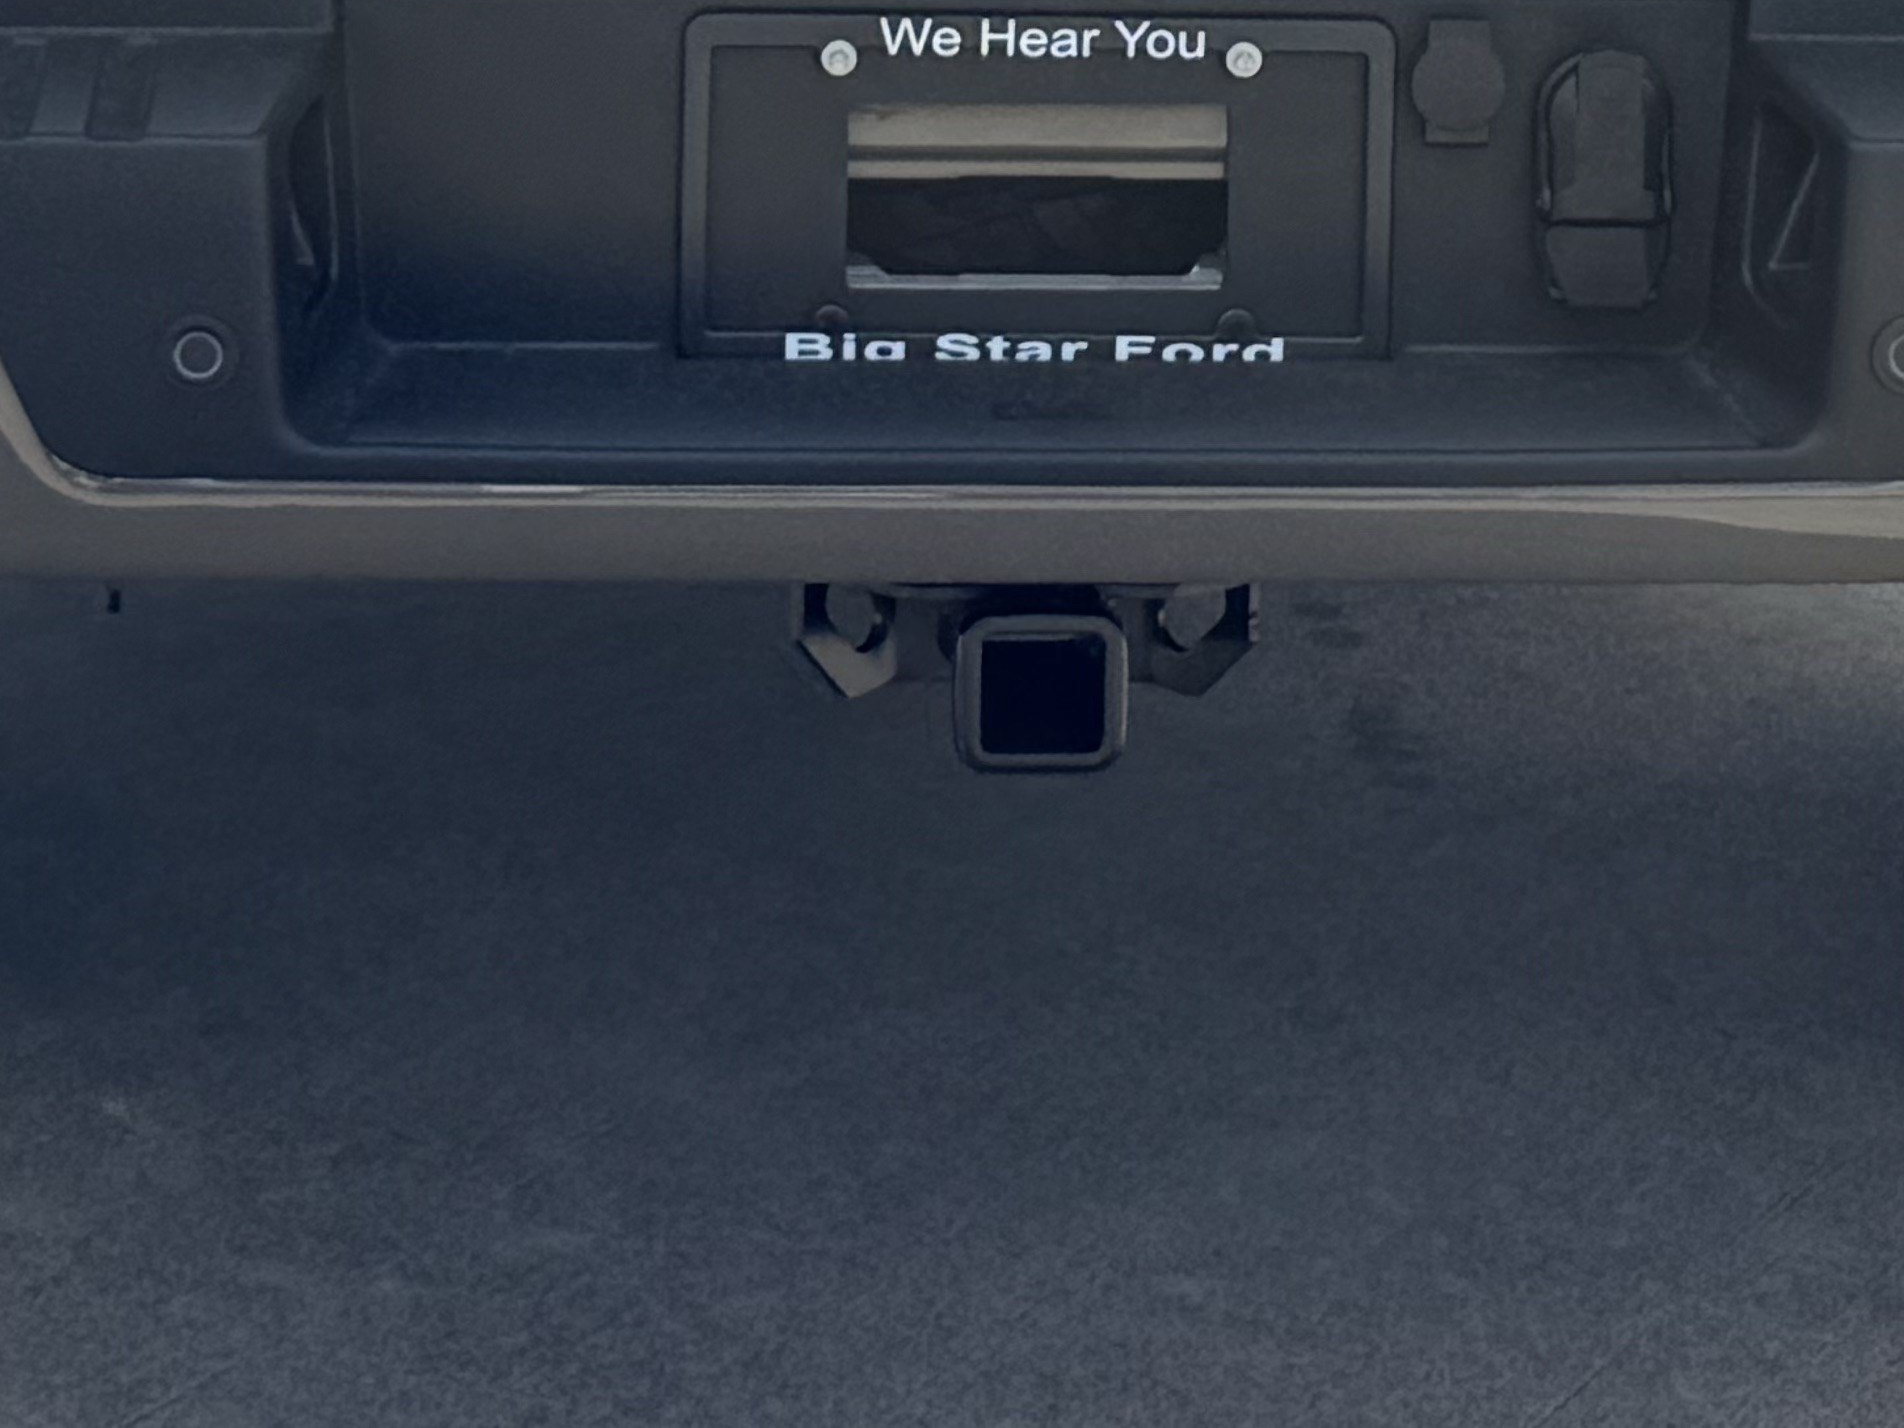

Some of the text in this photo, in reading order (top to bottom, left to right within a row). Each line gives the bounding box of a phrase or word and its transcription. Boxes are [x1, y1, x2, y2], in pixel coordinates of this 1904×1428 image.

[879, 16, 1206, 59] We Hear You
[934, 332, 1089, 362] Star
[1114, 334, 1284, 363] Ford
